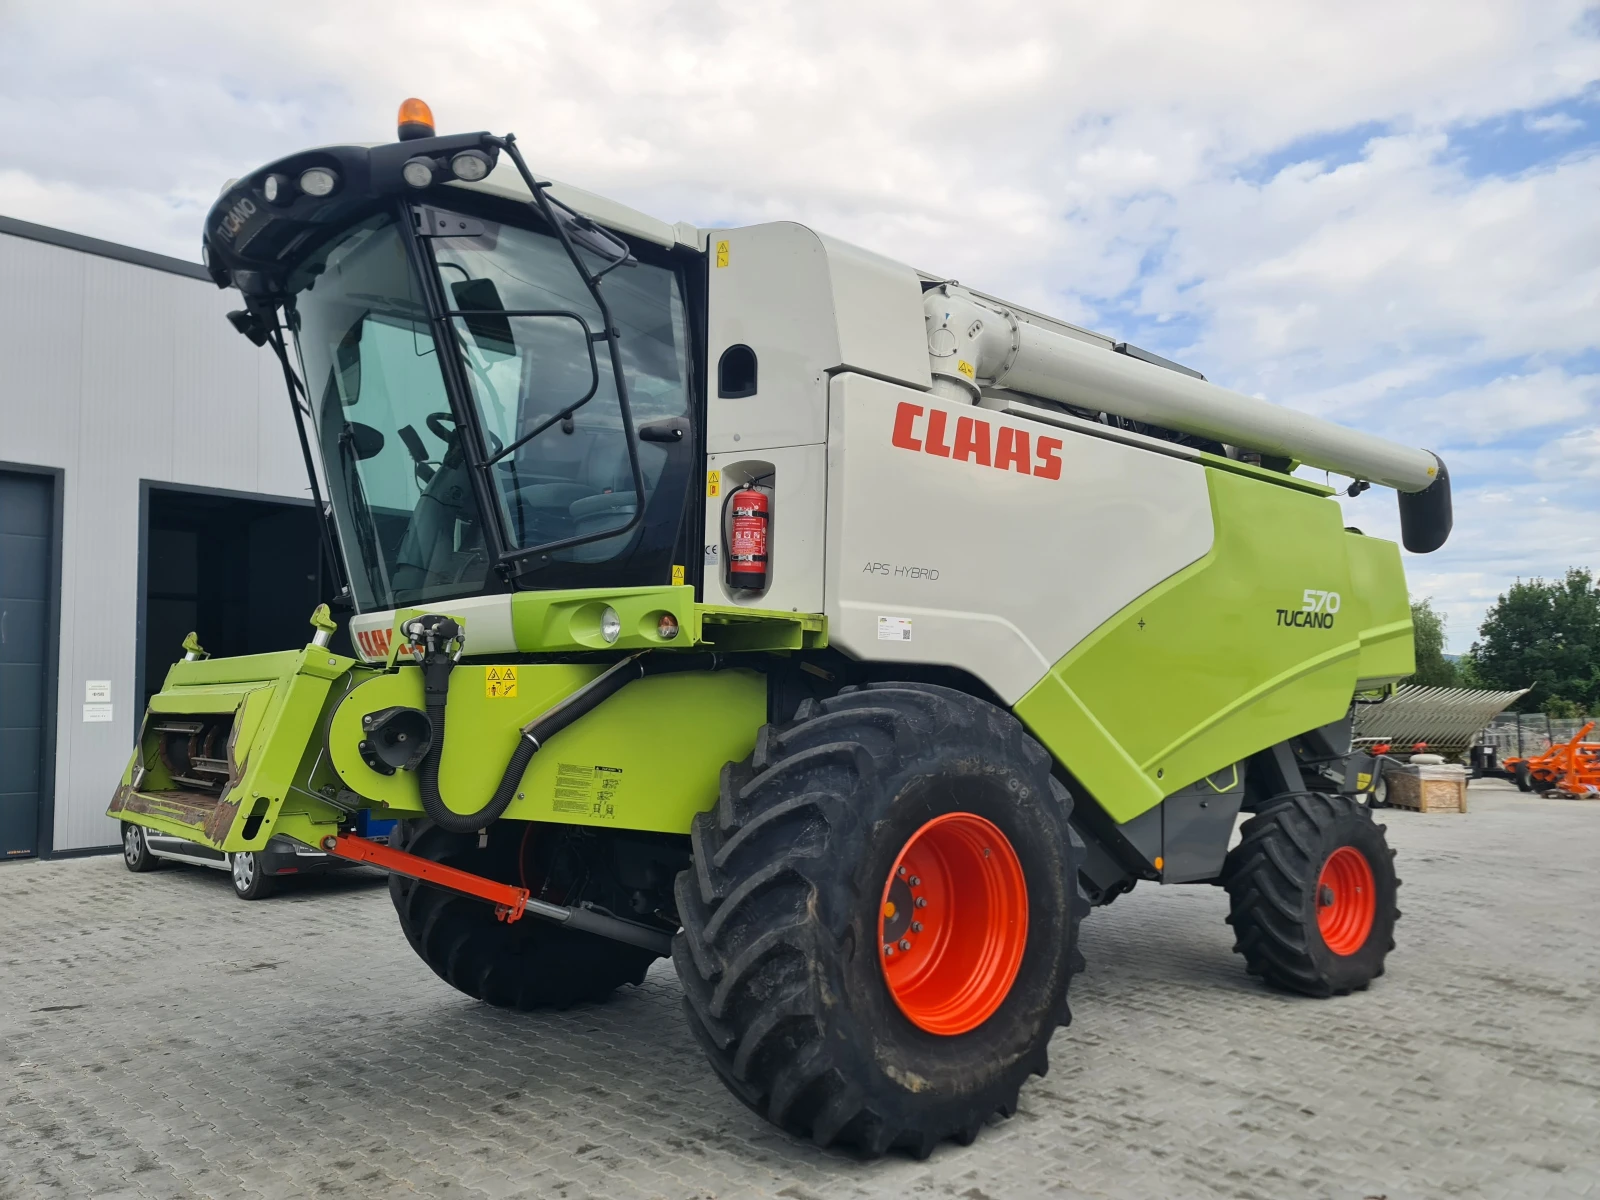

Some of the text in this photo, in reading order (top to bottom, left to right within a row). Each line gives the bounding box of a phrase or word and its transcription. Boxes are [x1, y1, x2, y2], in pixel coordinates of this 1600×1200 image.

[217, 197, 257, 243] TUCANO
[891, 401, 1063, 481] CLAAS
[862, 562, 940, 581] APS HYBRID
[1302, 589, 1341, 614] 570
[1276, 609, 1334, 630] TUCANO
